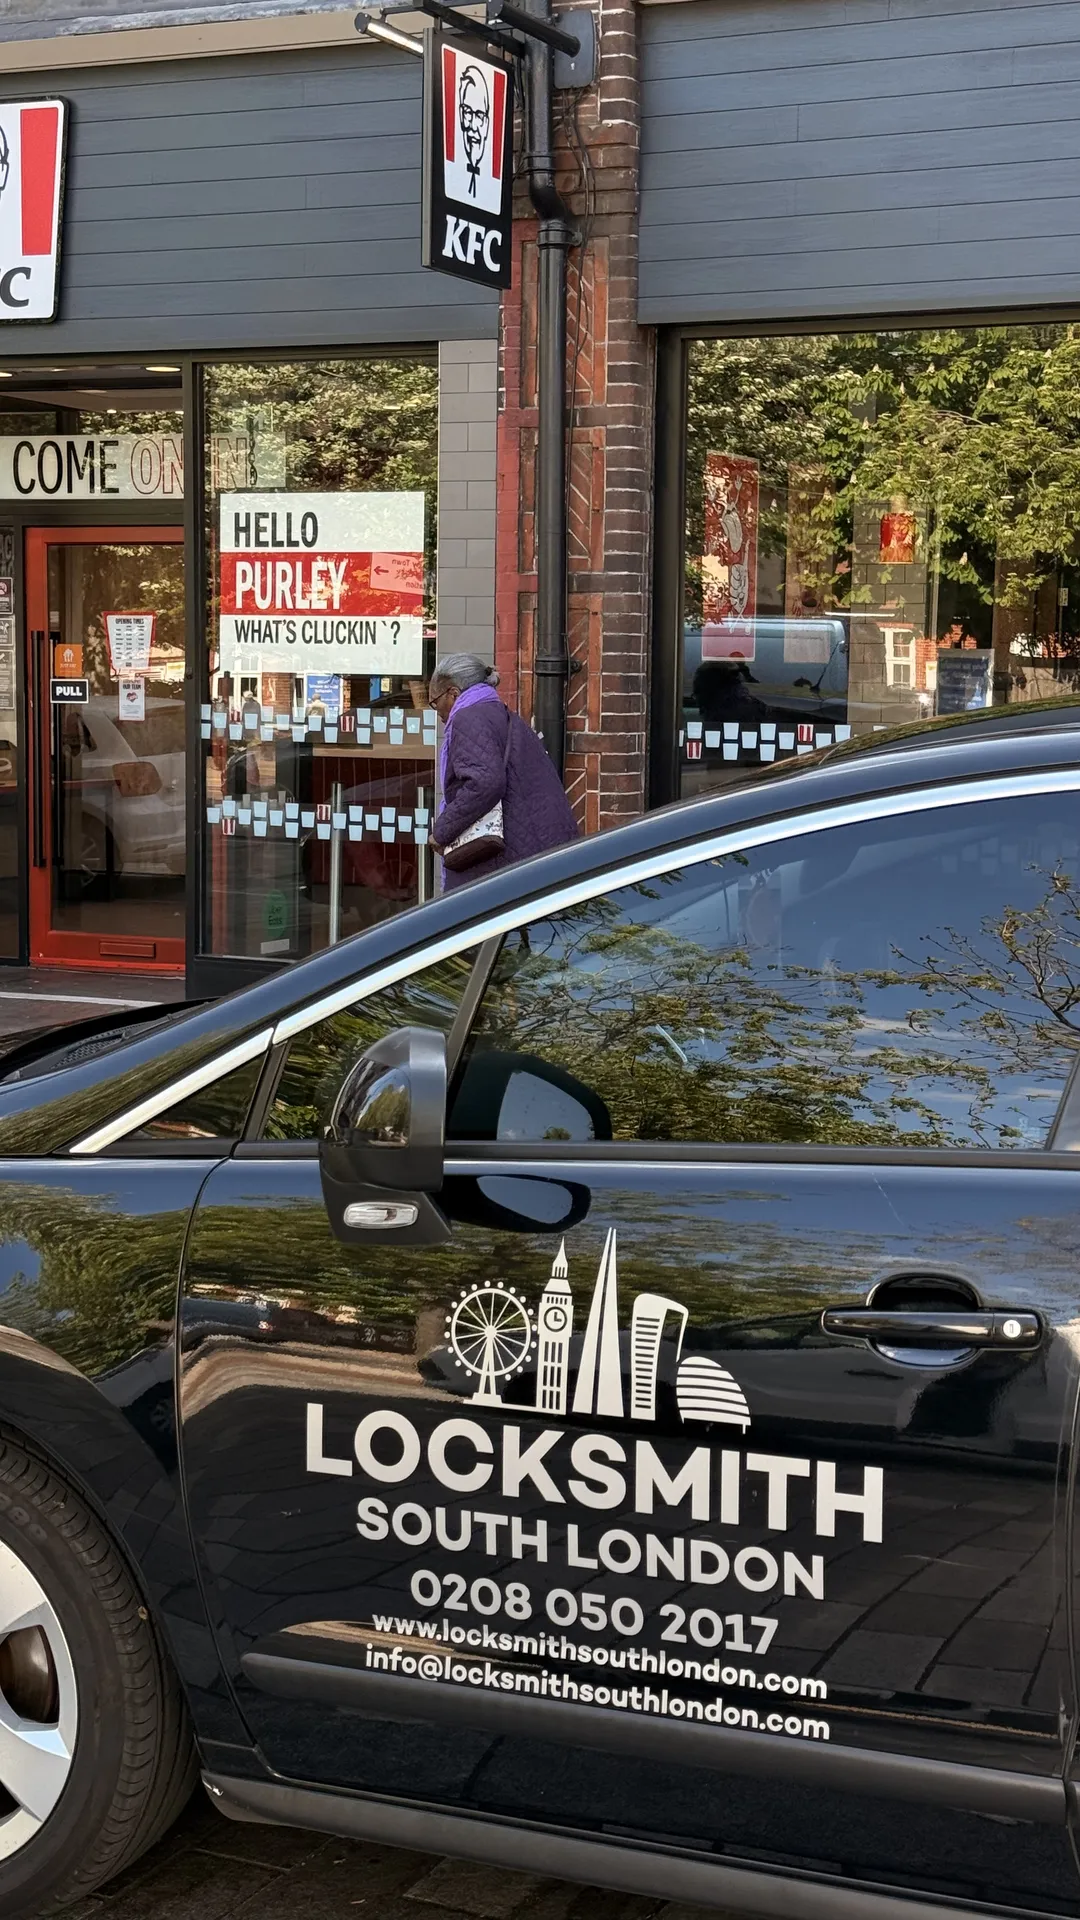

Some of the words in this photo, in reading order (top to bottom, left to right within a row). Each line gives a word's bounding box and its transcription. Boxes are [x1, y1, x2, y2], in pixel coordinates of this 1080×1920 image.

[442, 214, 503, 273] KFC
[13, 440, 119, 494] COME
[130, 437, 184, 494] ON
[234, 511, 318, 548] HELLO
[235, 560, 348, 610] PURLEY
[234, 619, 297, 644] WHAT'S
[301, 620, 377, 645] CLUCKIN
[55, 686, 83, 697] PULL
[306, 1402, 884, 1544] LOCKSMITH
[356, 1497, 548, 1563] SOUTH
[567, 1523, 824, 1600] LONDON
[410, 1569, 533, 1620] 0208
[545, 1588, 644, 1636] 050
[659, 1603, 779, 1655] 2017
[372, 1614, 828, 1700] www.locksmithsouthlondon.com
[365, 1643, 830, 1740] info@locksmithsouthlondon.com
